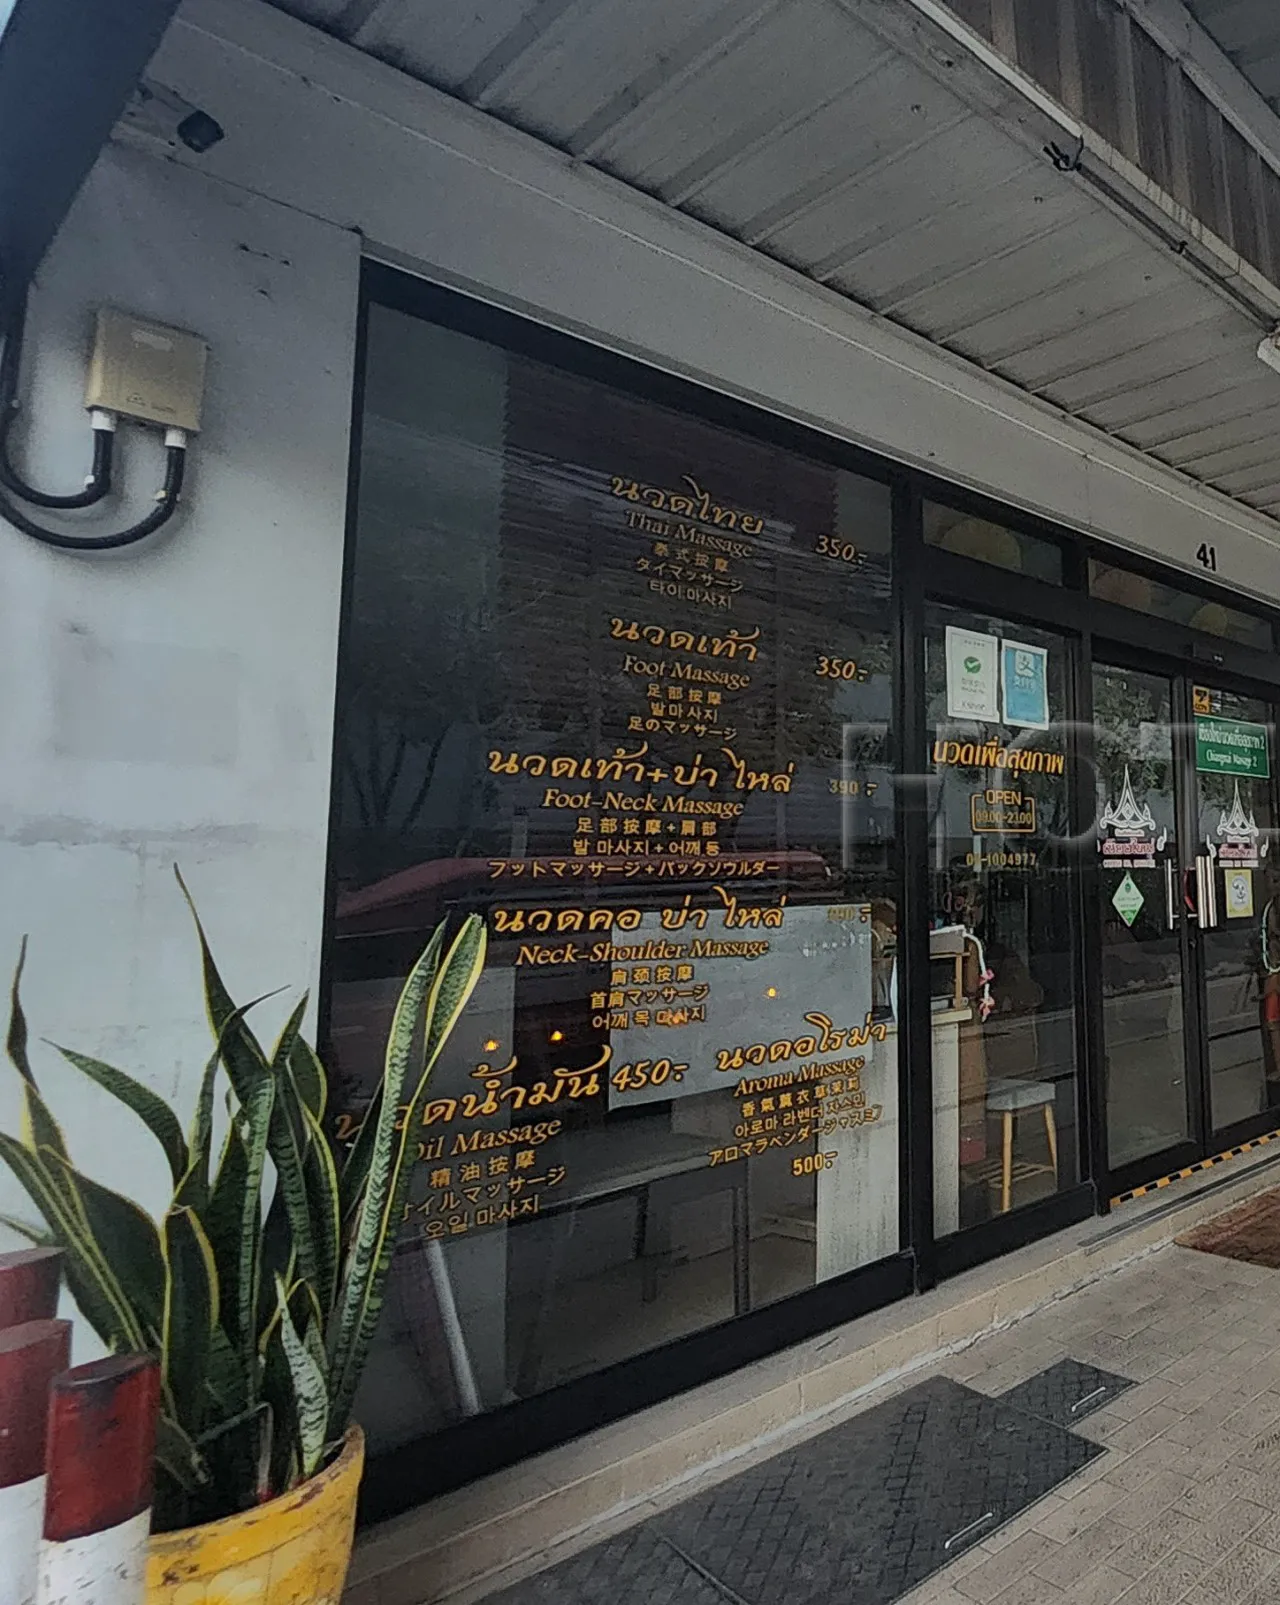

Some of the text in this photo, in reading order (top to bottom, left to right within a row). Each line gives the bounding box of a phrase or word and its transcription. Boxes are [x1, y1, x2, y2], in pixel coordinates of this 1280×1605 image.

[611, 472, 764, 535] นวดไทย
[625, 509, 753, 559] Thai Massage
[636, 557, 744, 593] タイマッサージ
[1196, 543, 1216, 572] 41
[610, 617, 762, 662] นวดเท้า
[623, 654, 751, 690] Foot Massage
[628, 715, 737, 741] 足のマッサージ
[933, 735, 1064, 778] นวดเพื่อสุขภาพ
[661, 796, 744, 818] Massage
[986, 789, 1022, 806] OPEN
[494, 886, 788, 933] นวดคอ บ่า ไหล่
[691, 939, 769, 958] Massage
[590, 985, 709, 1010] 首肩マッサージ
[717, 1011, 887, 1071] นวดอโรม่า
[734, 1056, 865, 1098] Aroma Massage
[450, 1119, 562, 1156] Massage
[735, 1115, 779, 1139] 아로마
[783, 1101, 825, 1127] 라벤더
[429, 1151, 537, 1188] 精油按摩
[425, 1195, 540, 1240] 오일 마사지
